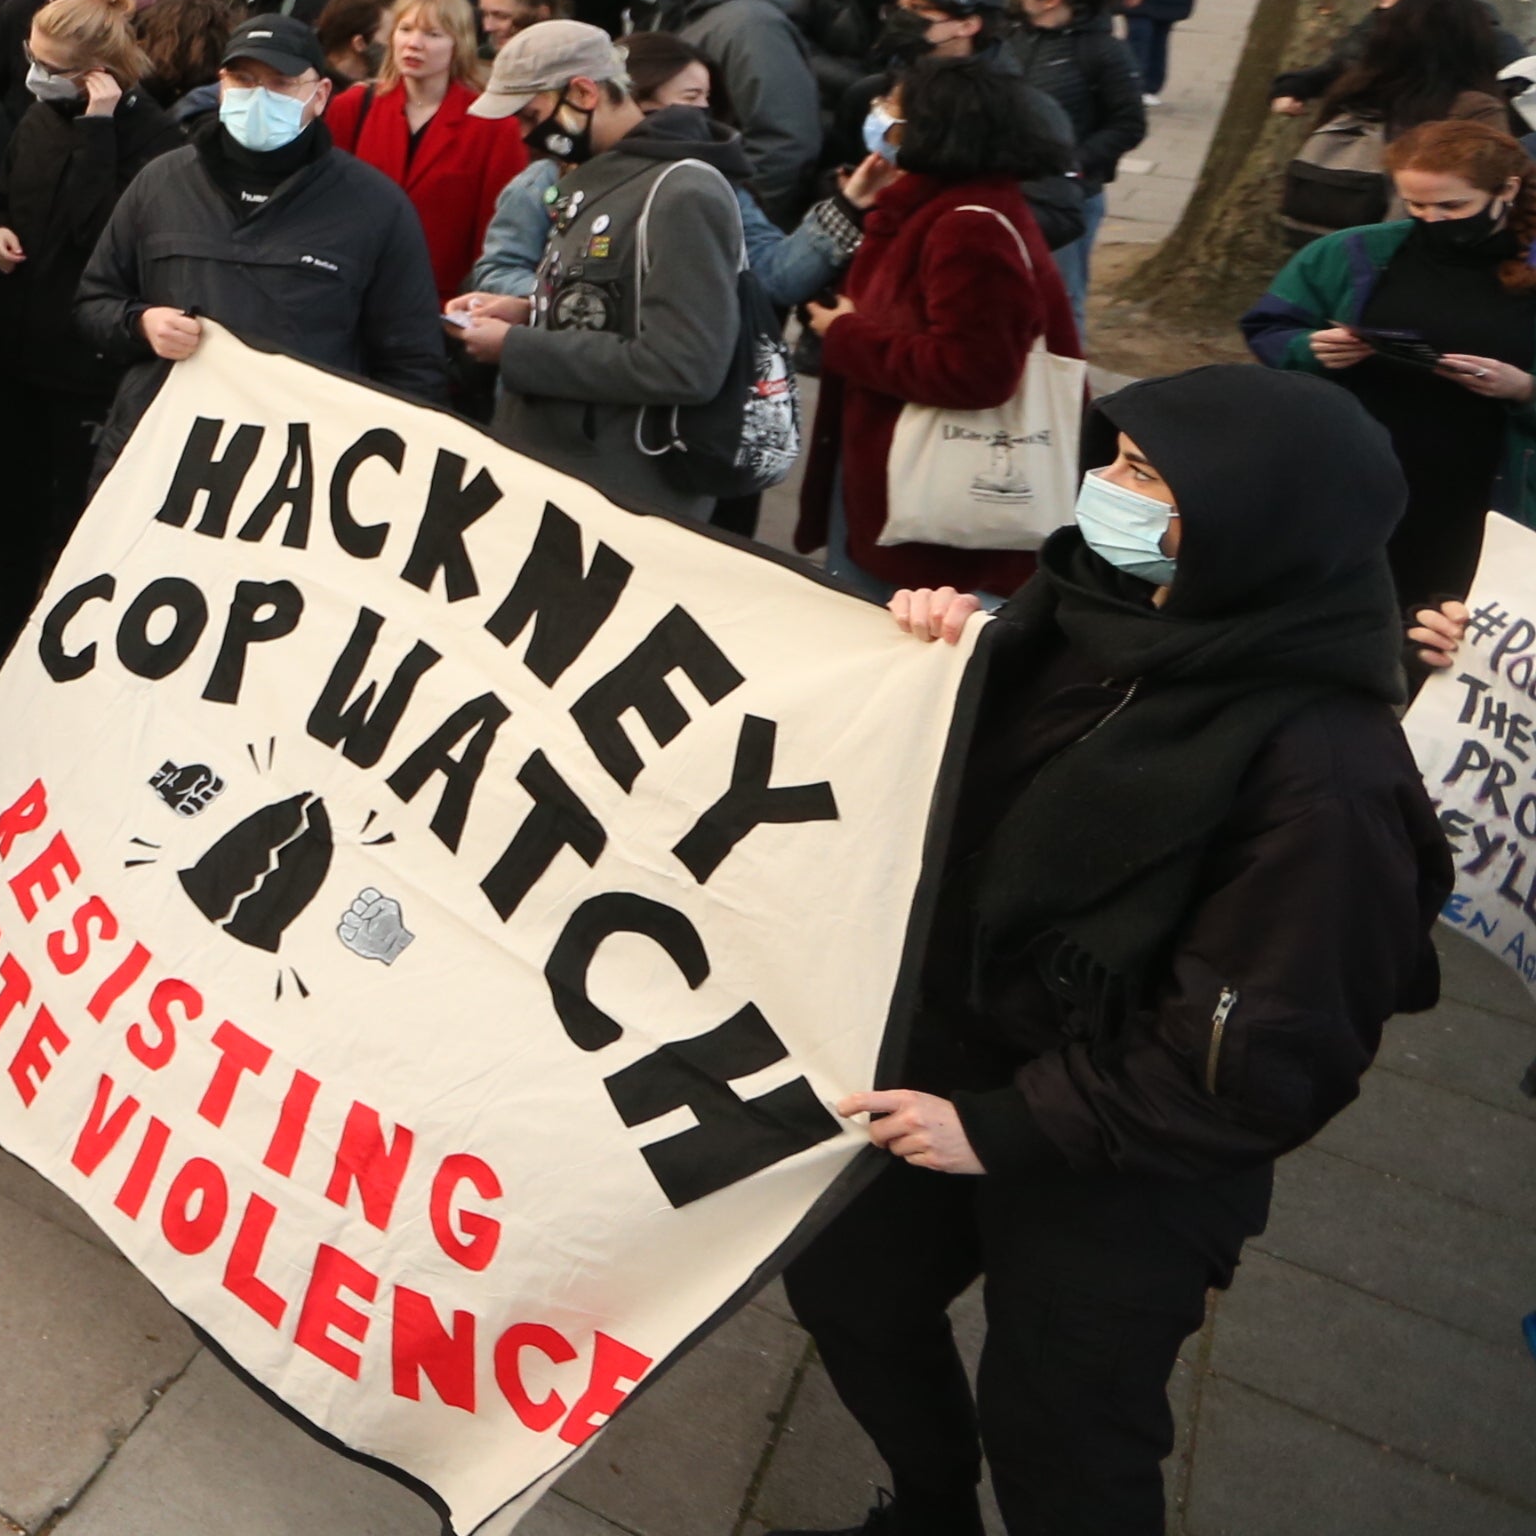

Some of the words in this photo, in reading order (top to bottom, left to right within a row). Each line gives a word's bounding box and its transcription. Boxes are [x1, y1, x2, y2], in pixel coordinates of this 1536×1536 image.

[155, 415, 839, 885] HACKNEY
[1442, 738, 1536, 841] PRO
[38, 572, 305, 704] COP
[306, 606, 845, 1209] WATCH
[70, 1072, 654, 1447] VIOLENCE
